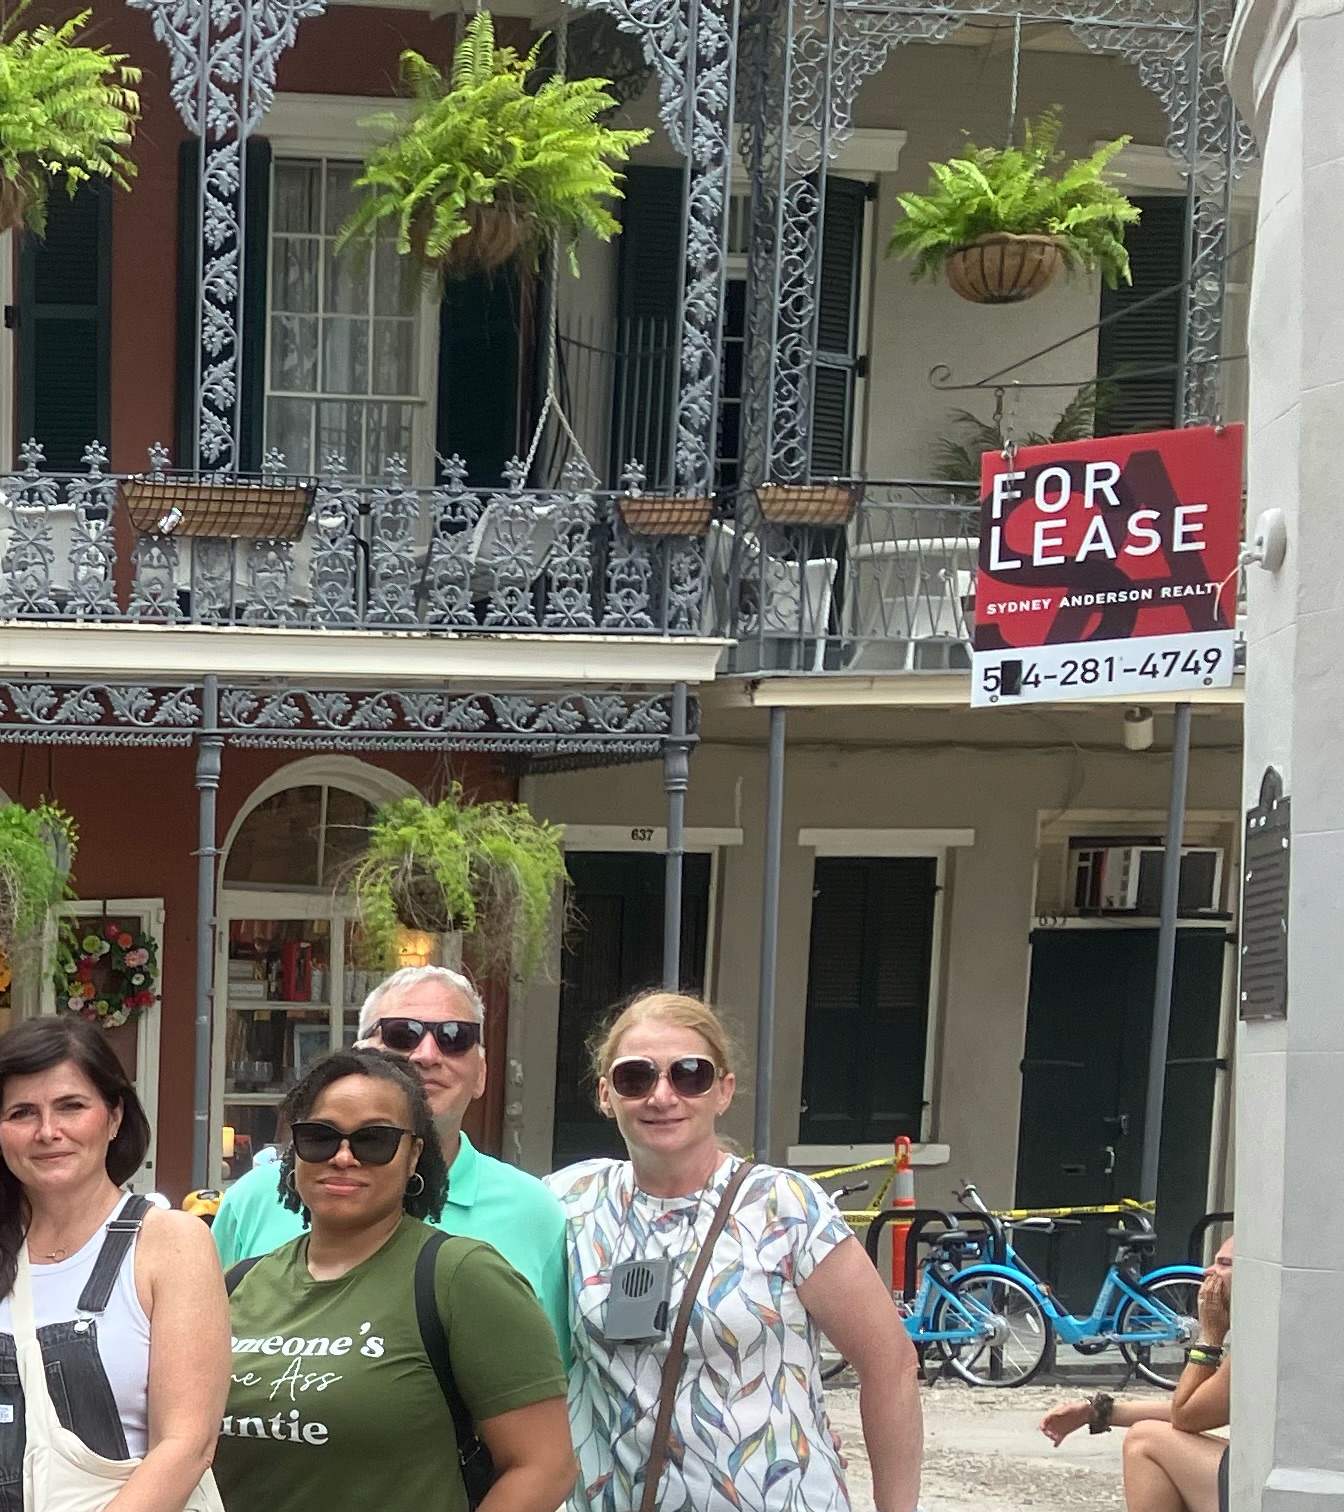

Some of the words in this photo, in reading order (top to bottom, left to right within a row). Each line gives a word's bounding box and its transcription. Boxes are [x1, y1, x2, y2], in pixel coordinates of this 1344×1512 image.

[991, 461, 1121, 519] FOR
[989, 504, 1208, 571] LEASE
[986, 598, 1052, 616] SYDNEY
[1059, 588, 1153, 608] ANDERSON
[1160, 582, 1225, 599] REALTY
[982, 648, 1222, 692] 54-281-4749
[631, 828, 654, 841] 637
[231, 1322, 385, 1358] meone's
[269, 1356, 343, 1401] Ass
